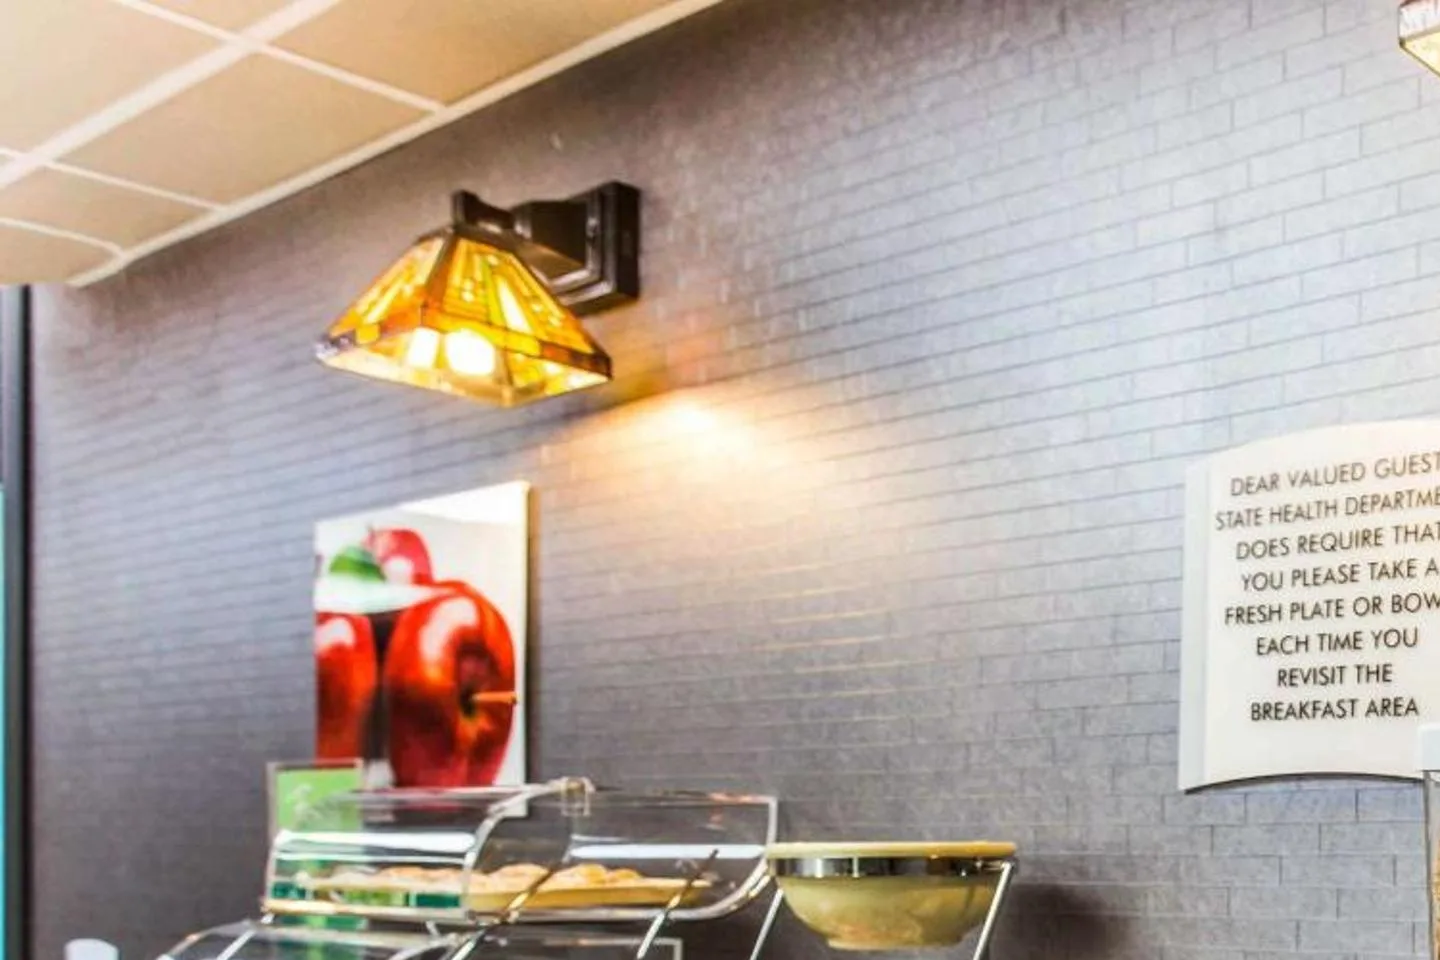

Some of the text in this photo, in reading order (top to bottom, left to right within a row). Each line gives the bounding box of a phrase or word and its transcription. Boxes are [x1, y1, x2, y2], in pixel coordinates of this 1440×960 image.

[1231, 472, 1280, 497] DEAR
[1288, 461, 1366, 488] VALUED
[1215, 508, 1263, 531] STATE
[1269, 499, 1338, 525] HEALTH
[1236, 536, 1290, 561] DOES
[1297, 527, 1383, 554] REQUIRE
[1240, 557, 1440, 592] YOU PLEASE TAKE A
[1224, 602, 1282, 625] FRESH
[1289, 599, 1345, 622] PLATE
[1352, 596, 1382, 617] OR
[1256, 627, 1418, 656] EACH TIME YOU
[1277, 664, 1393, 687] REVISIT THE
[1250, 697, 1420, 722] BREAKFAST AREA
